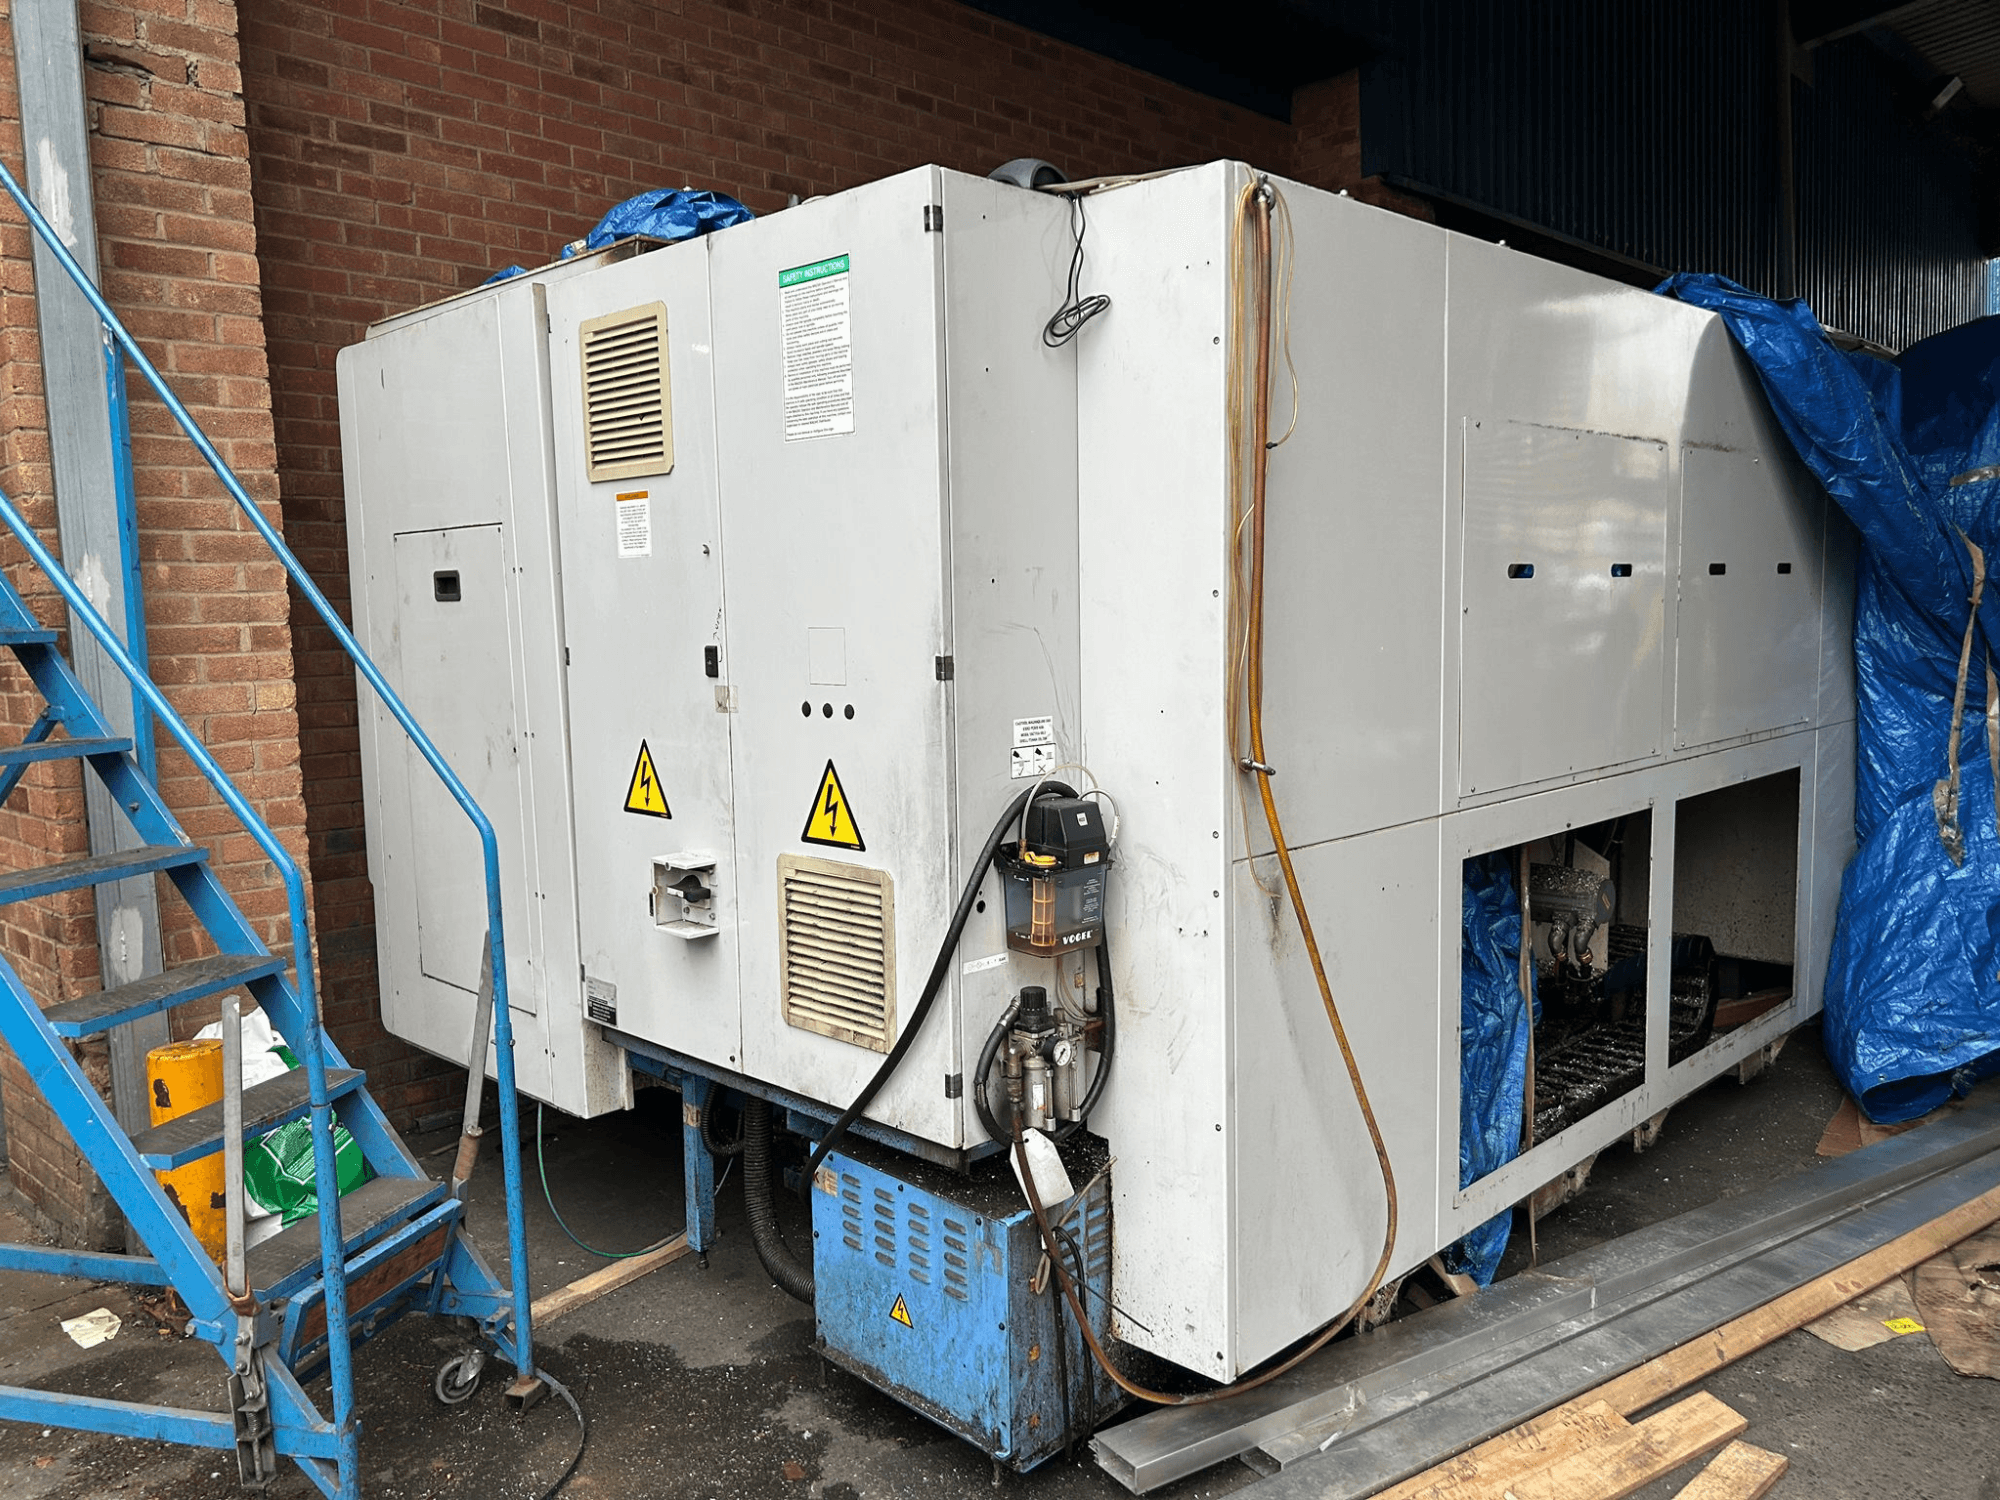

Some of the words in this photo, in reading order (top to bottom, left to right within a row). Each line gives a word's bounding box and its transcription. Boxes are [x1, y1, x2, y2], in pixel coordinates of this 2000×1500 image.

[782, 270, 802, 284] SAFETY
[804, 259, 845, 277] INSTRUCTIONS
[1062, 930, 1092, 945] VOGEL
